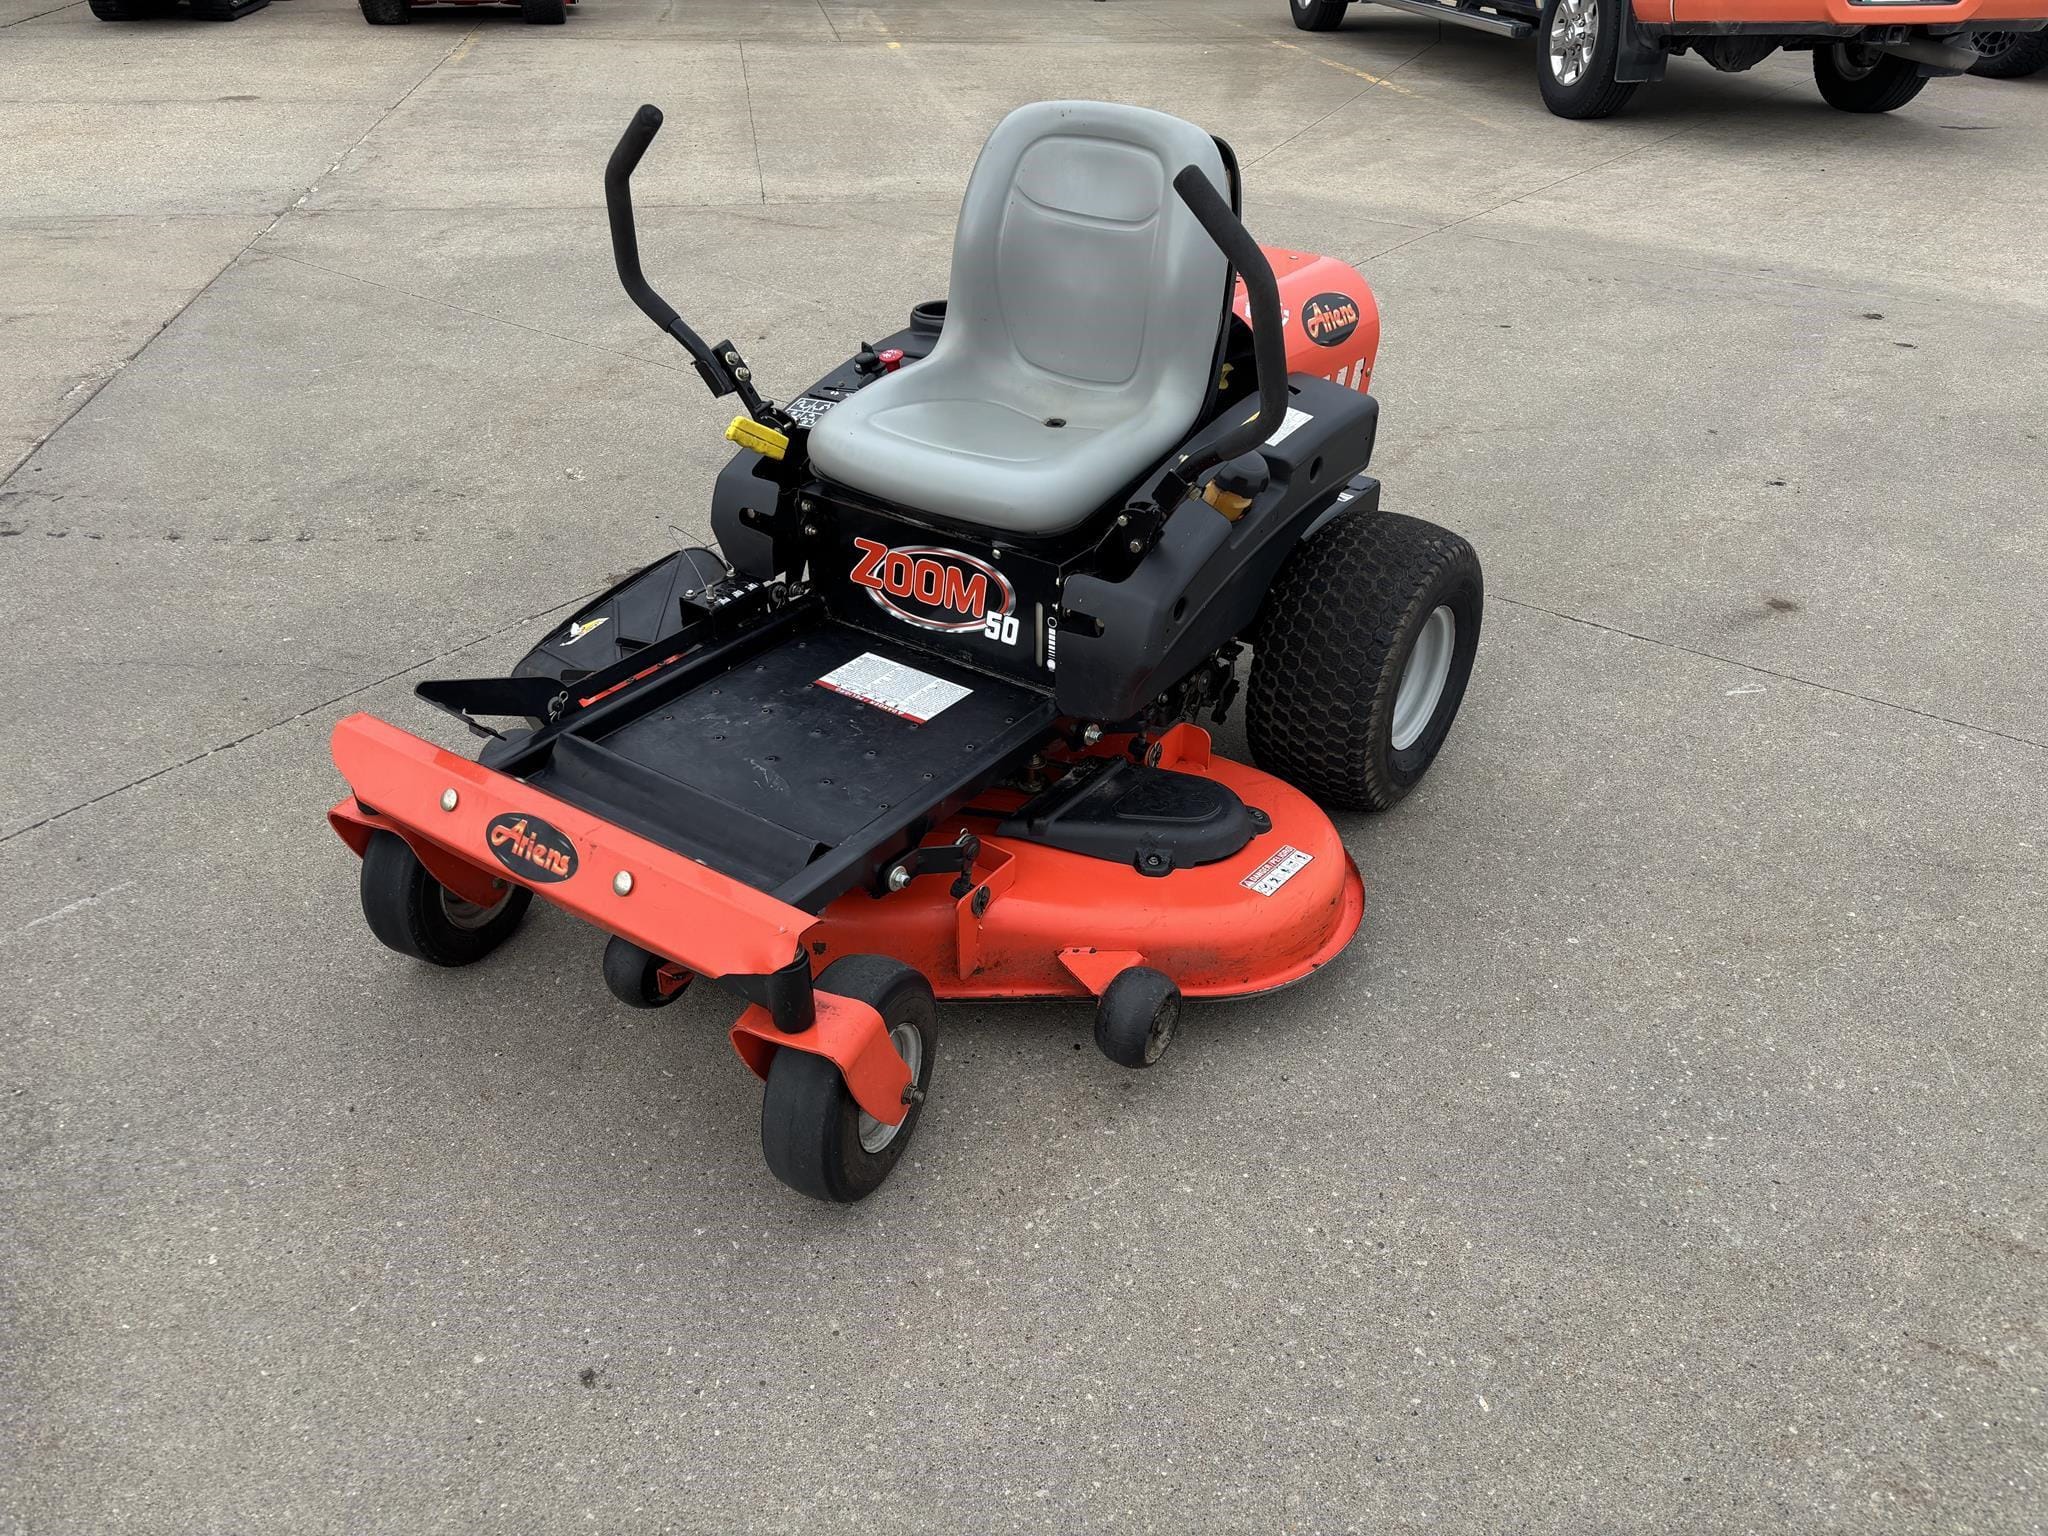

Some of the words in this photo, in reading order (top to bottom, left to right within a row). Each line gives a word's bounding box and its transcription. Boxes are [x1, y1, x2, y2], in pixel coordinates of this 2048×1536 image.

[1307, 302, 1358, 338] Ariens
[850, 536, 988, 619] ZOOM
[984, 610, 1020, 646] 50
[491, 819, 571, 878] Ariens
